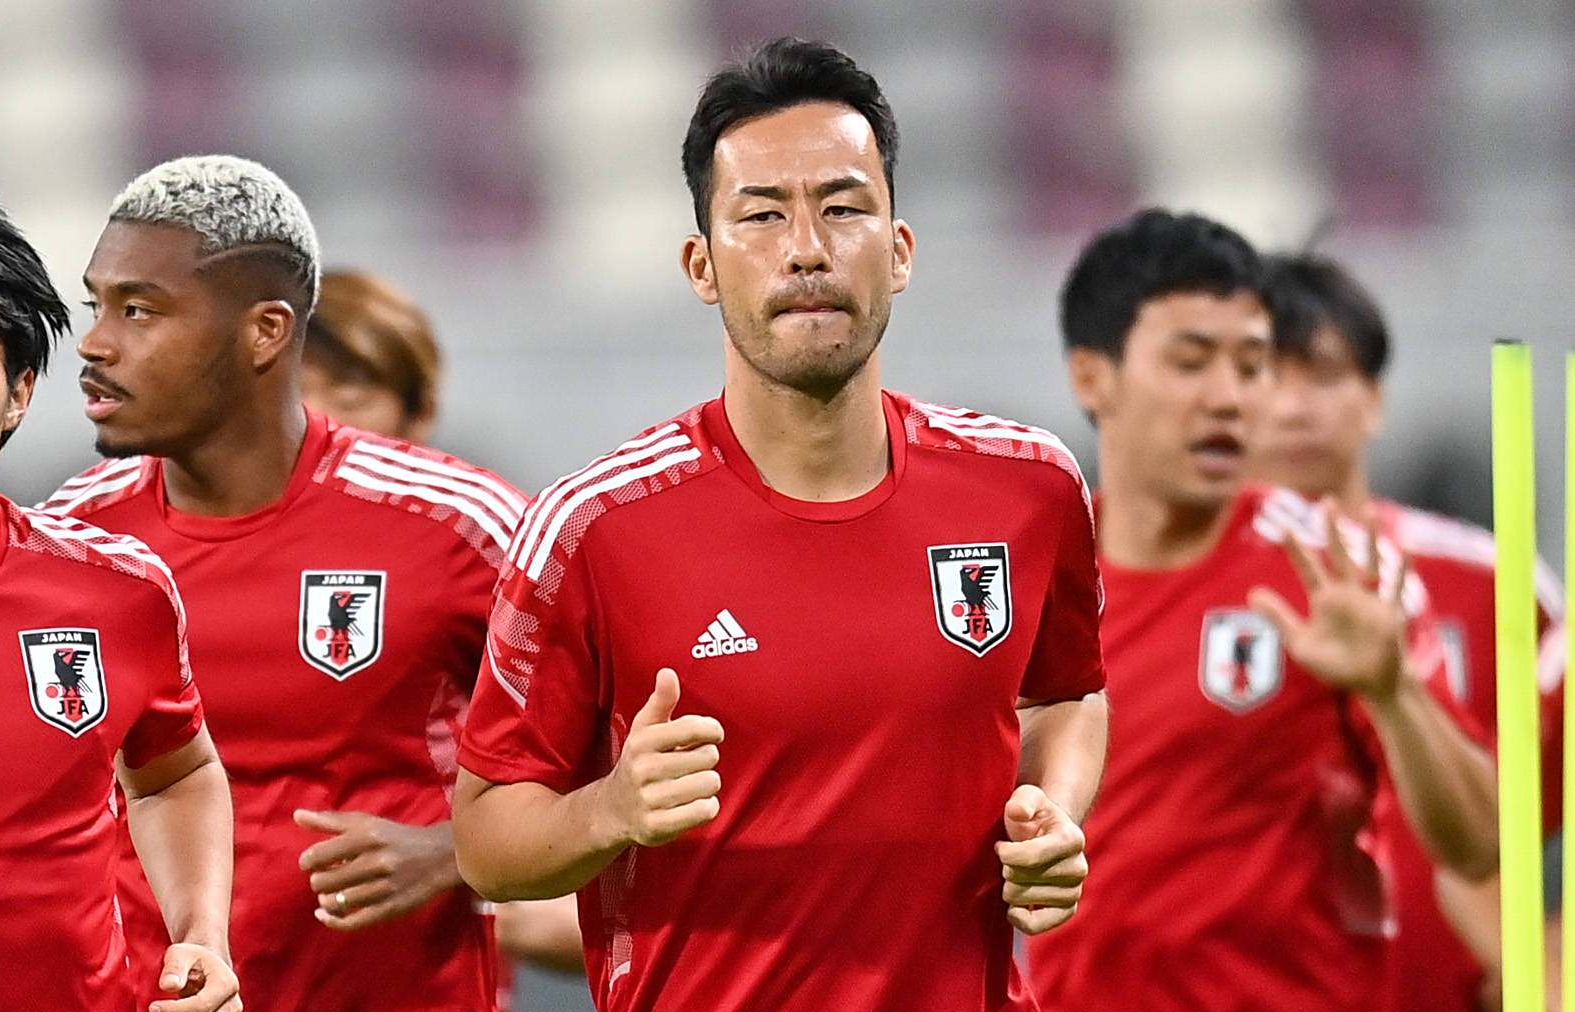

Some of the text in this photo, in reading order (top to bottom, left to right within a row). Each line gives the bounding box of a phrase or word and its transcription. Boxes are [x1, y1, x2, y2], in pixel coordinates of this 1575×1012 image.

[949, 548, 990, 559] JAPAN
[321, 575, 365, 585] JAPAN
[962, 618, 994, 635] JFA
[41, 632, 83, 643] JAPAN
[322, 643, 357, 659] JFA
[691, 637, 759, 659] adidas
[56, 699, 90, 715] JFA
